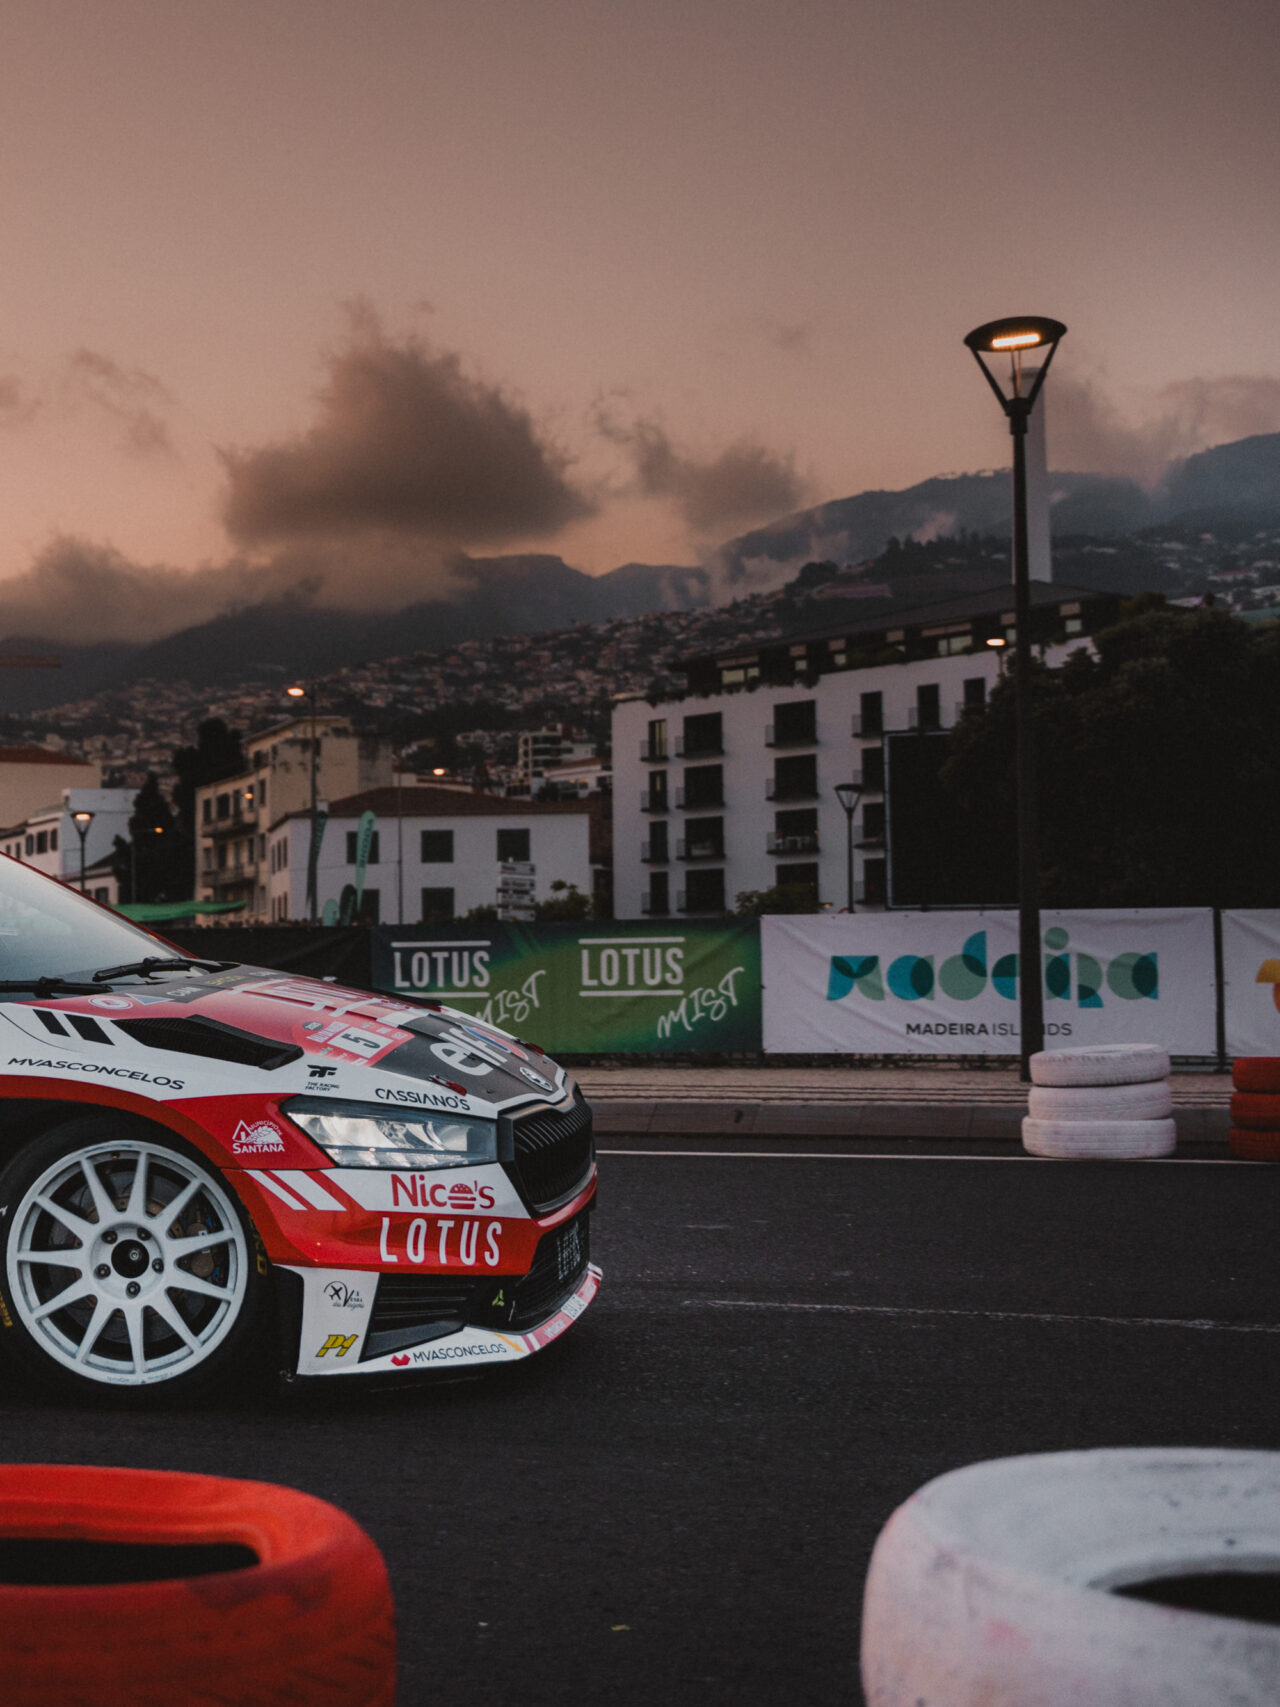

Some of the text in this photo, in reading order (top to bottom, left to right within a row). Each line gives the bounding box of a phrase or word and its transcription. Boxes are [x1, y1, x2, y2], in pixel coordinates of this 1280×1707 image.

[394, 950, 491, 988] LOTUS
[580, 947, 684, 987] LOTUS
[657, 966, 745, 1040] MIST
[905, 1022, 1073, 1037] MADEIRA ISLDS
[7, 1057, 186, 1091] MVASCONCELOS
[374, 1087, 471, 1111] CASSIANO'S
[232, 1142, 286, 1155] SANTANA
[379, 1216, 502, 1267] LOTUS
[413, 1343, 507, 1363] MVASCONCELOS
